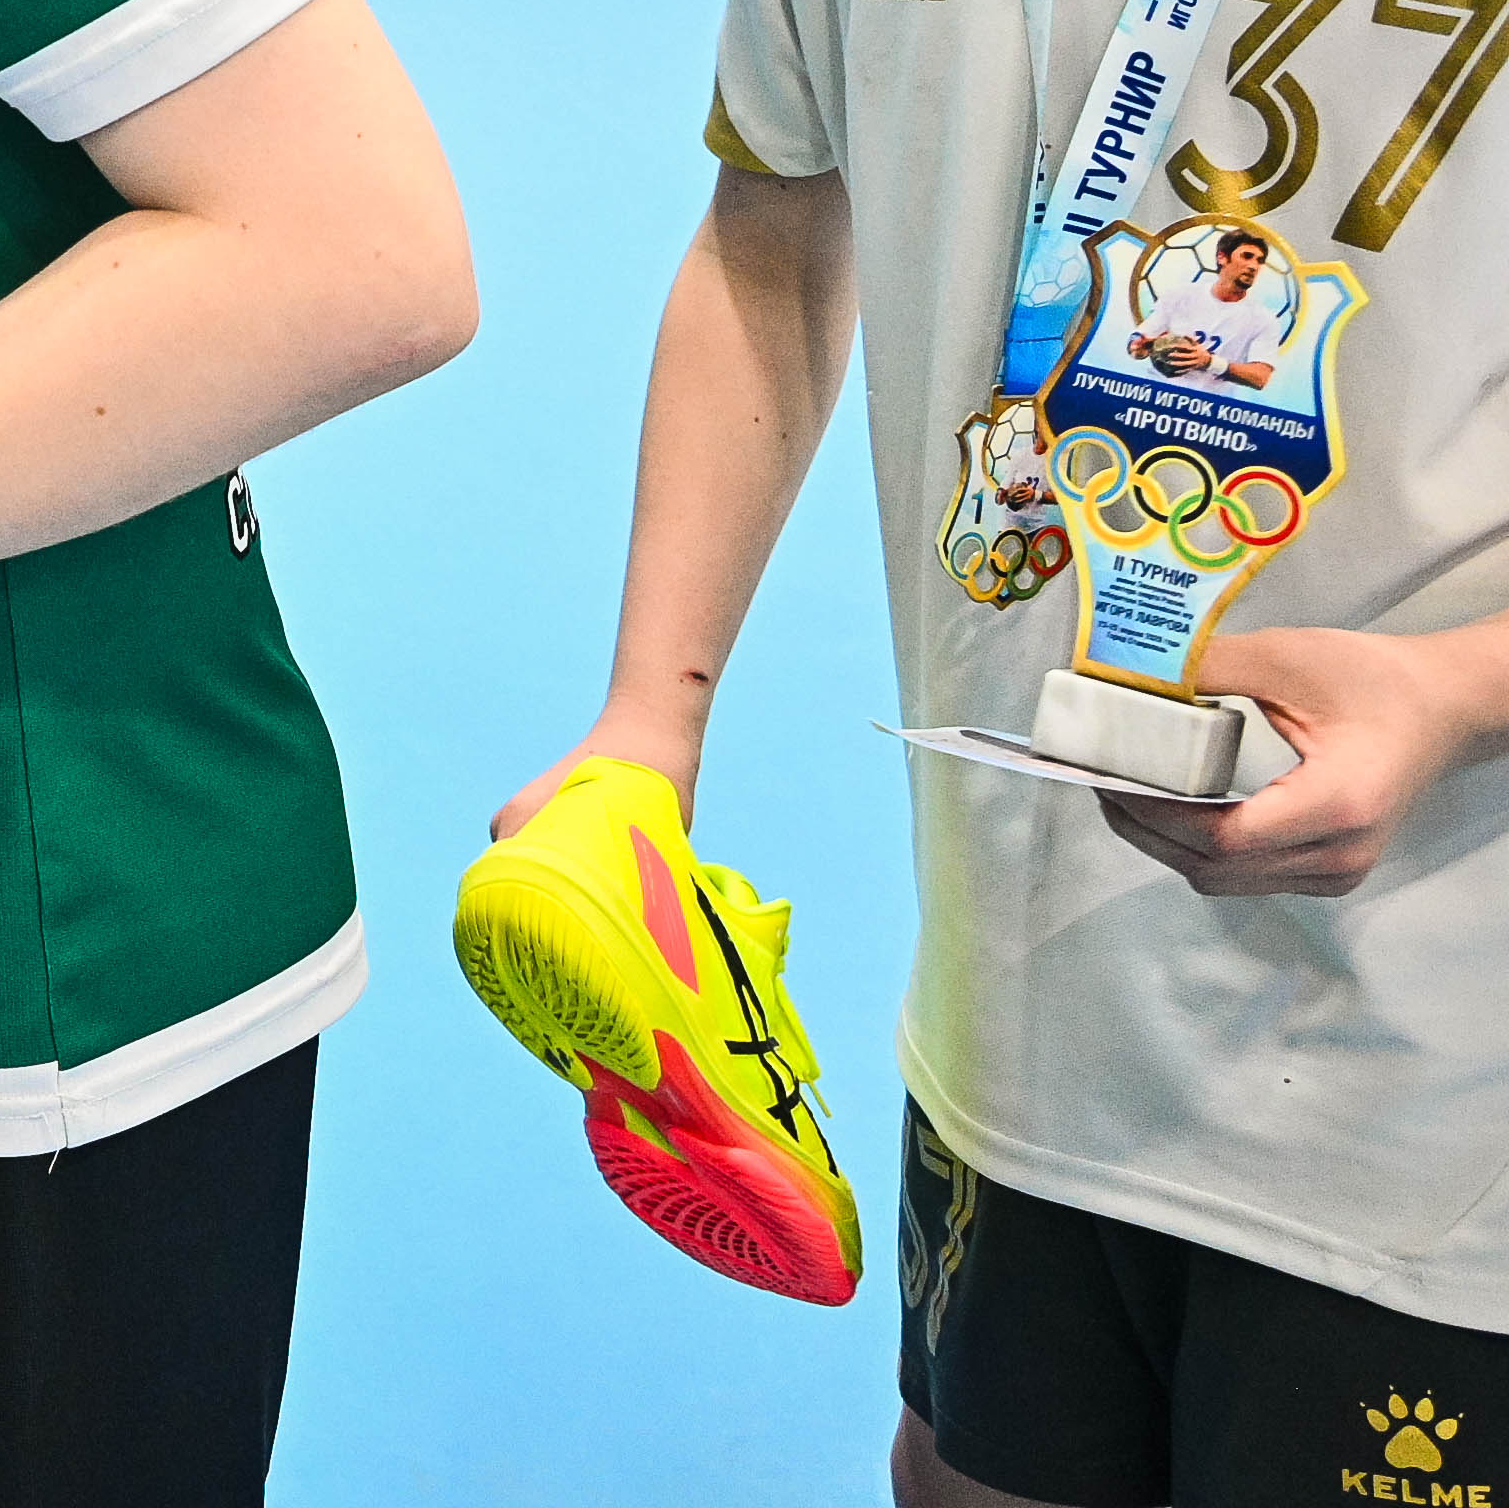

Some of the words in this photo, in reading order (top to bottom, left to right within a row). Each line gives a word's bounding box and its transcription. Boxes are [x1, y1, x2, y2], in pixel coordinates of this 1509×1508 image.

[1074, 51, 1167, 202] ТУРНИР
[1071, 371, 1153, 403] ЛУЧШИЙ
[1154, 389, 1214, 417] ИГРОК
[1216, 403, 1317, 440] КОМАНДЫ
[1114, 406, 1258, 452] «ПРОТВИНО»
[1113, 555, 1125, 572] II
[1130, 558, 1198, 589] ТУРНИР
[1341, 1468, 1493, 1508] KELME
